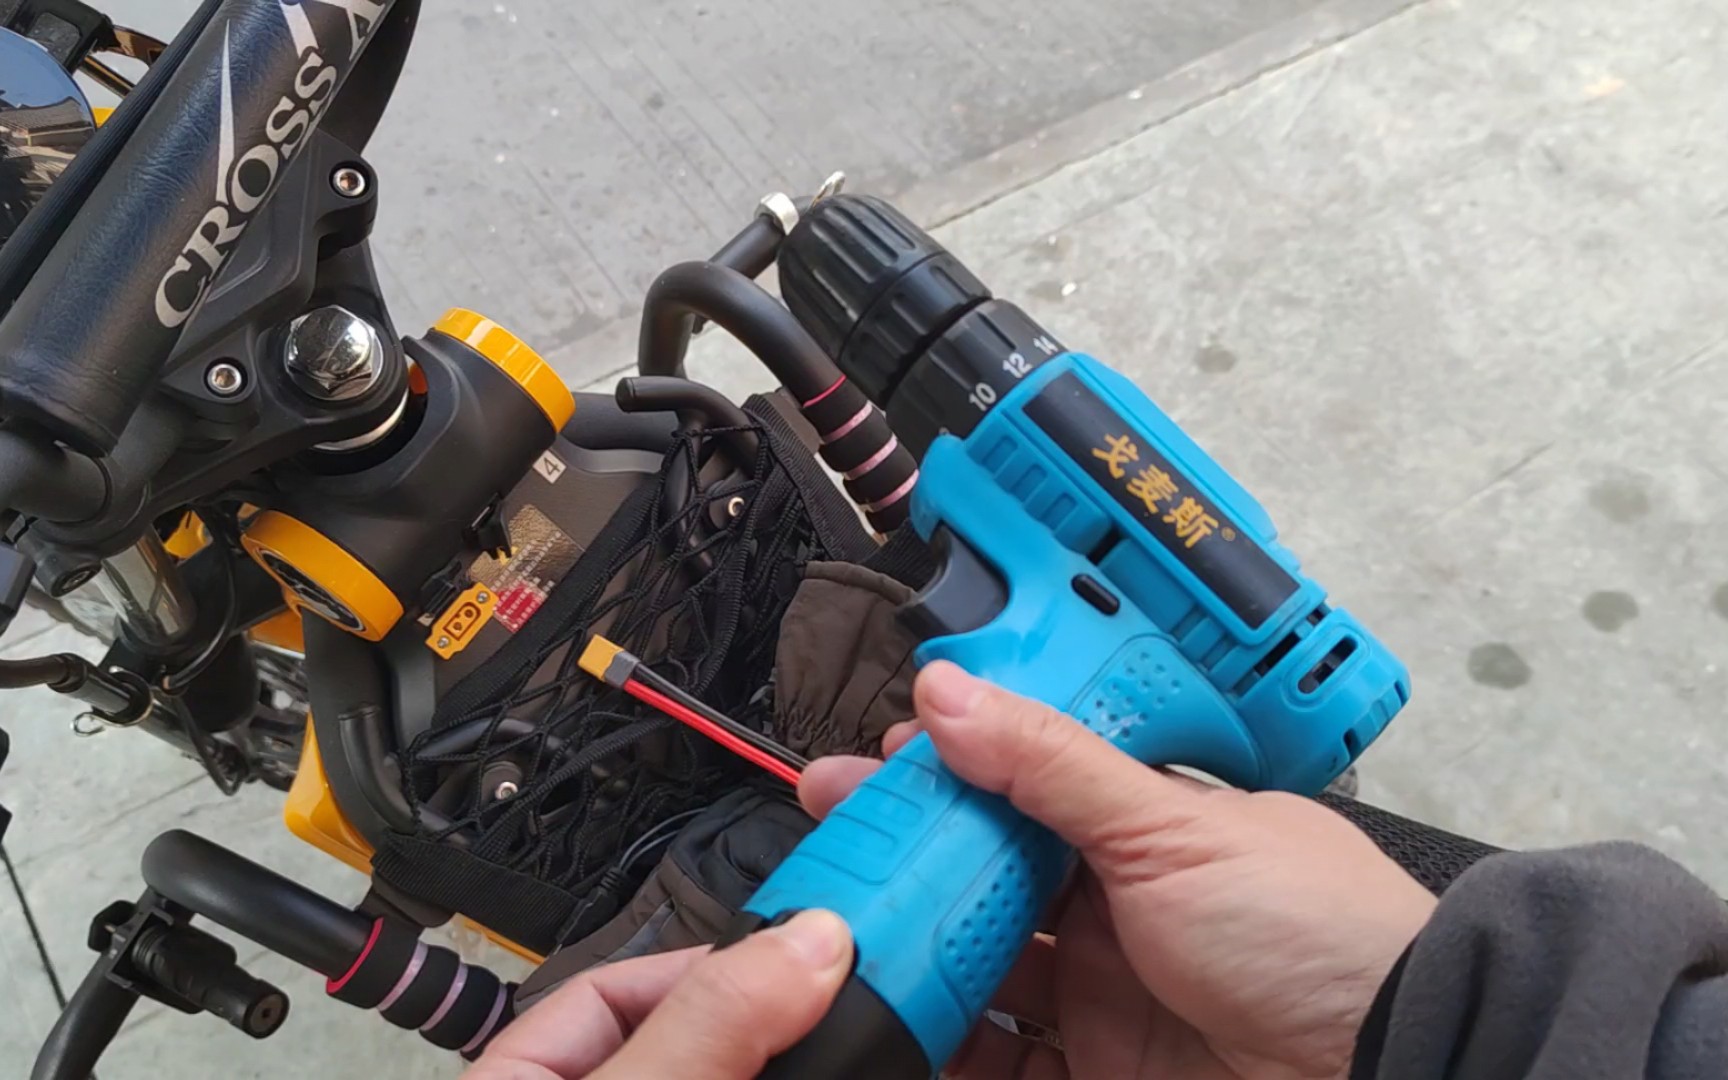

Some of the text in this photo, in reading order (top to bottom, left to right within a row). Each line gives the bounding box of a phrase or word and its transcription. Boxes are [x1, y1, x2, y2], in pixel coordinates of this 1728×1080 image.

[154, 51, 337, 329] CROSS
[1032, 335, 1059, 356] 14
[1003, 352, 1033, 379] 12
[969, 382, 997, 411] 10
[543, 457, 561, 476] 4
